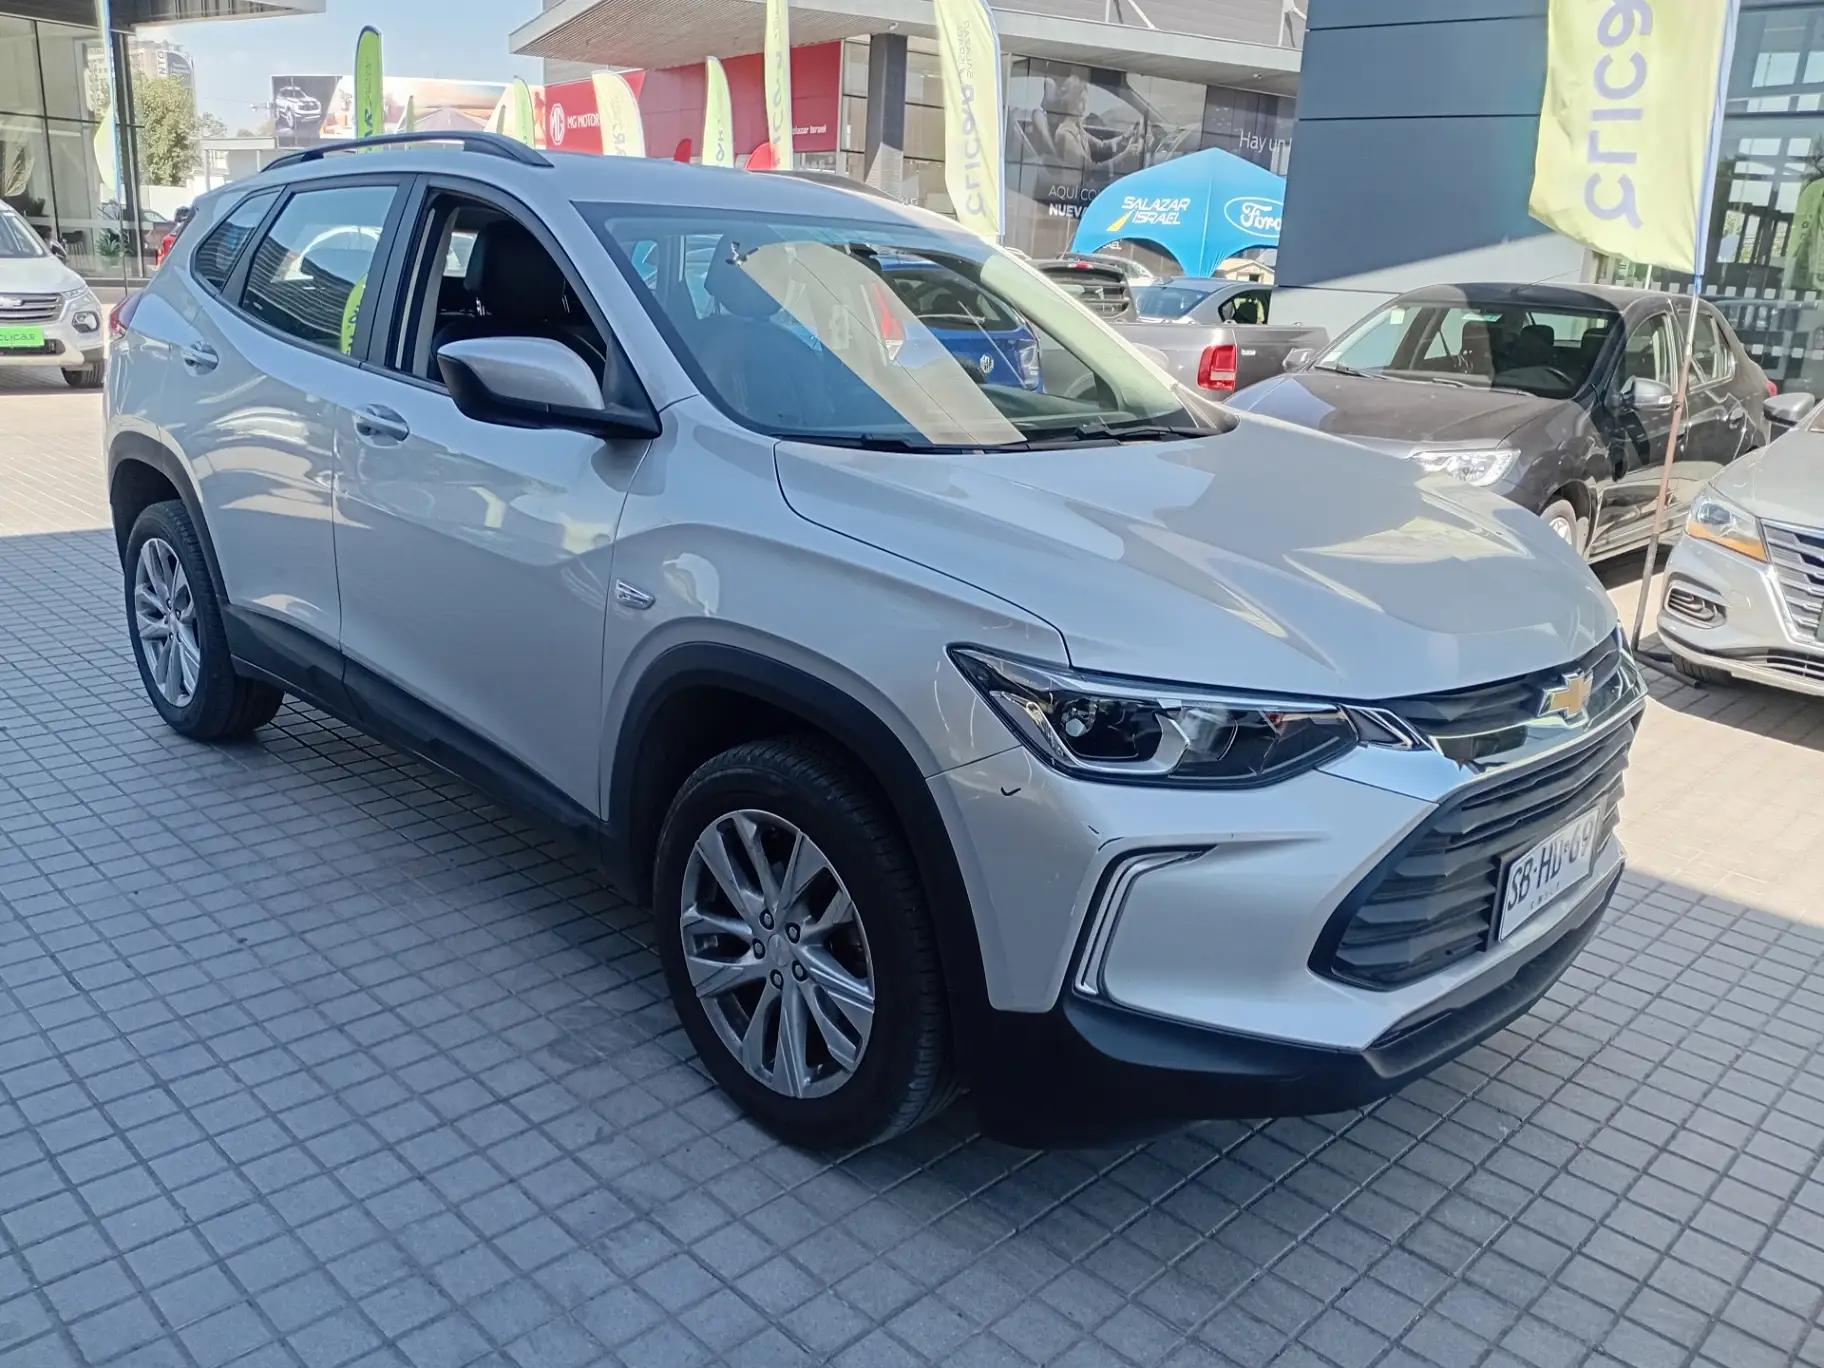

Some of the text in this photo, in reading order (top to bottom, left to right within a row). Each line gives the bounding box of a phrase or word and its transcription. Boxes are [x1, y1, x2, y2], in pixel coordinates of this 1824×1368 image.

[567, 115, 577, 129] MG
[1239, 128, 1267, 153] Hay
[1121, 196, 1191, 211] SALAZAR
[1132, 210, 1181, 225] ISRAEL
